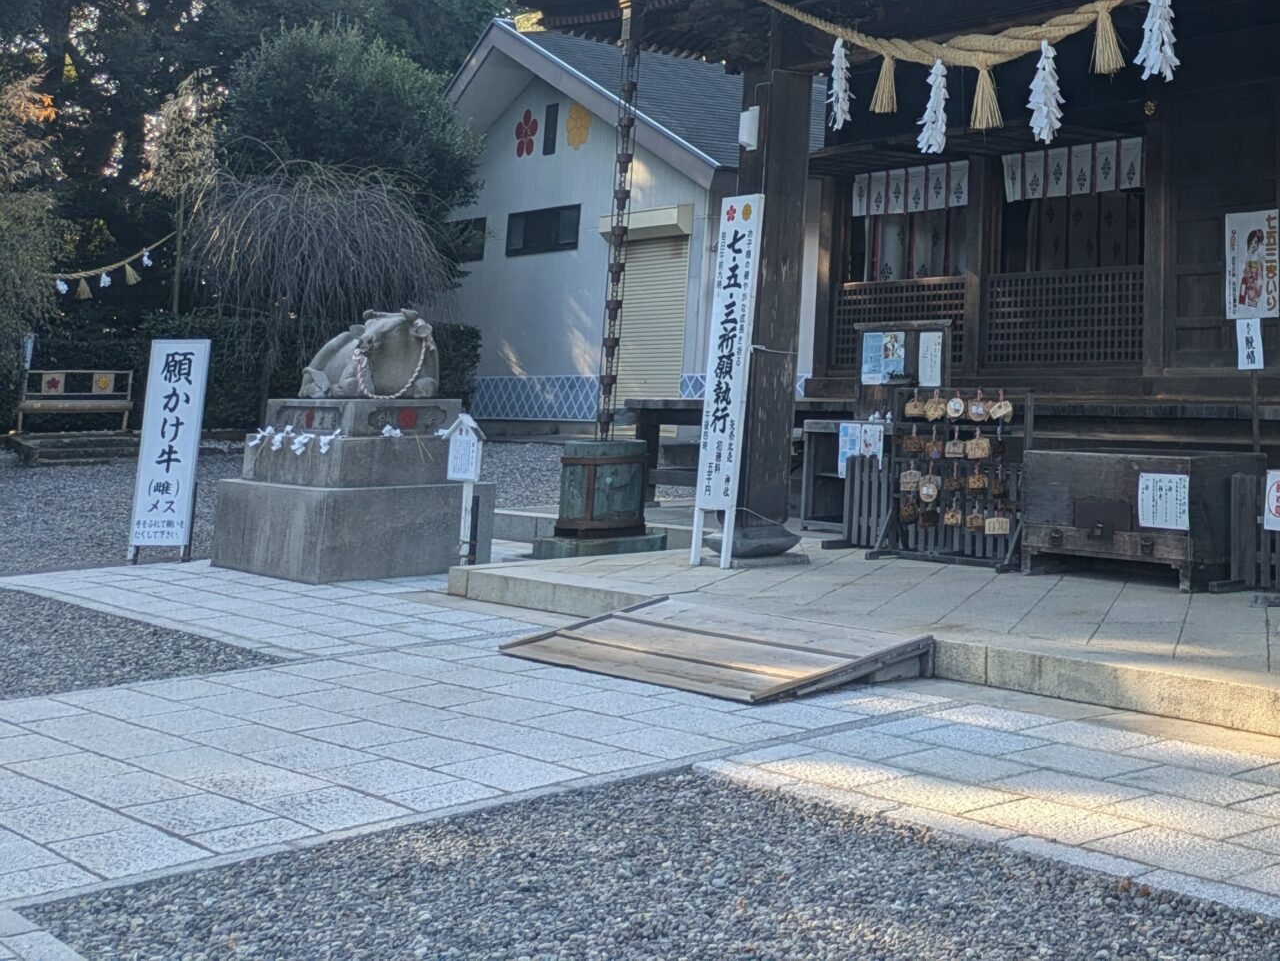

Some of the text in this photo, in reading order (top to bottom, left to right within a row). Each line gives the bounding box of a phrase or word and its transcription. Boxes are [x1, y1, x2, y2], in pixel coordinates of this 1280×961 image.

[1265, 214, 1278, 312] 七五三まいり
[155, 351, 195, 473] 願かけ牛
[147, 500, 175, 513] メス
